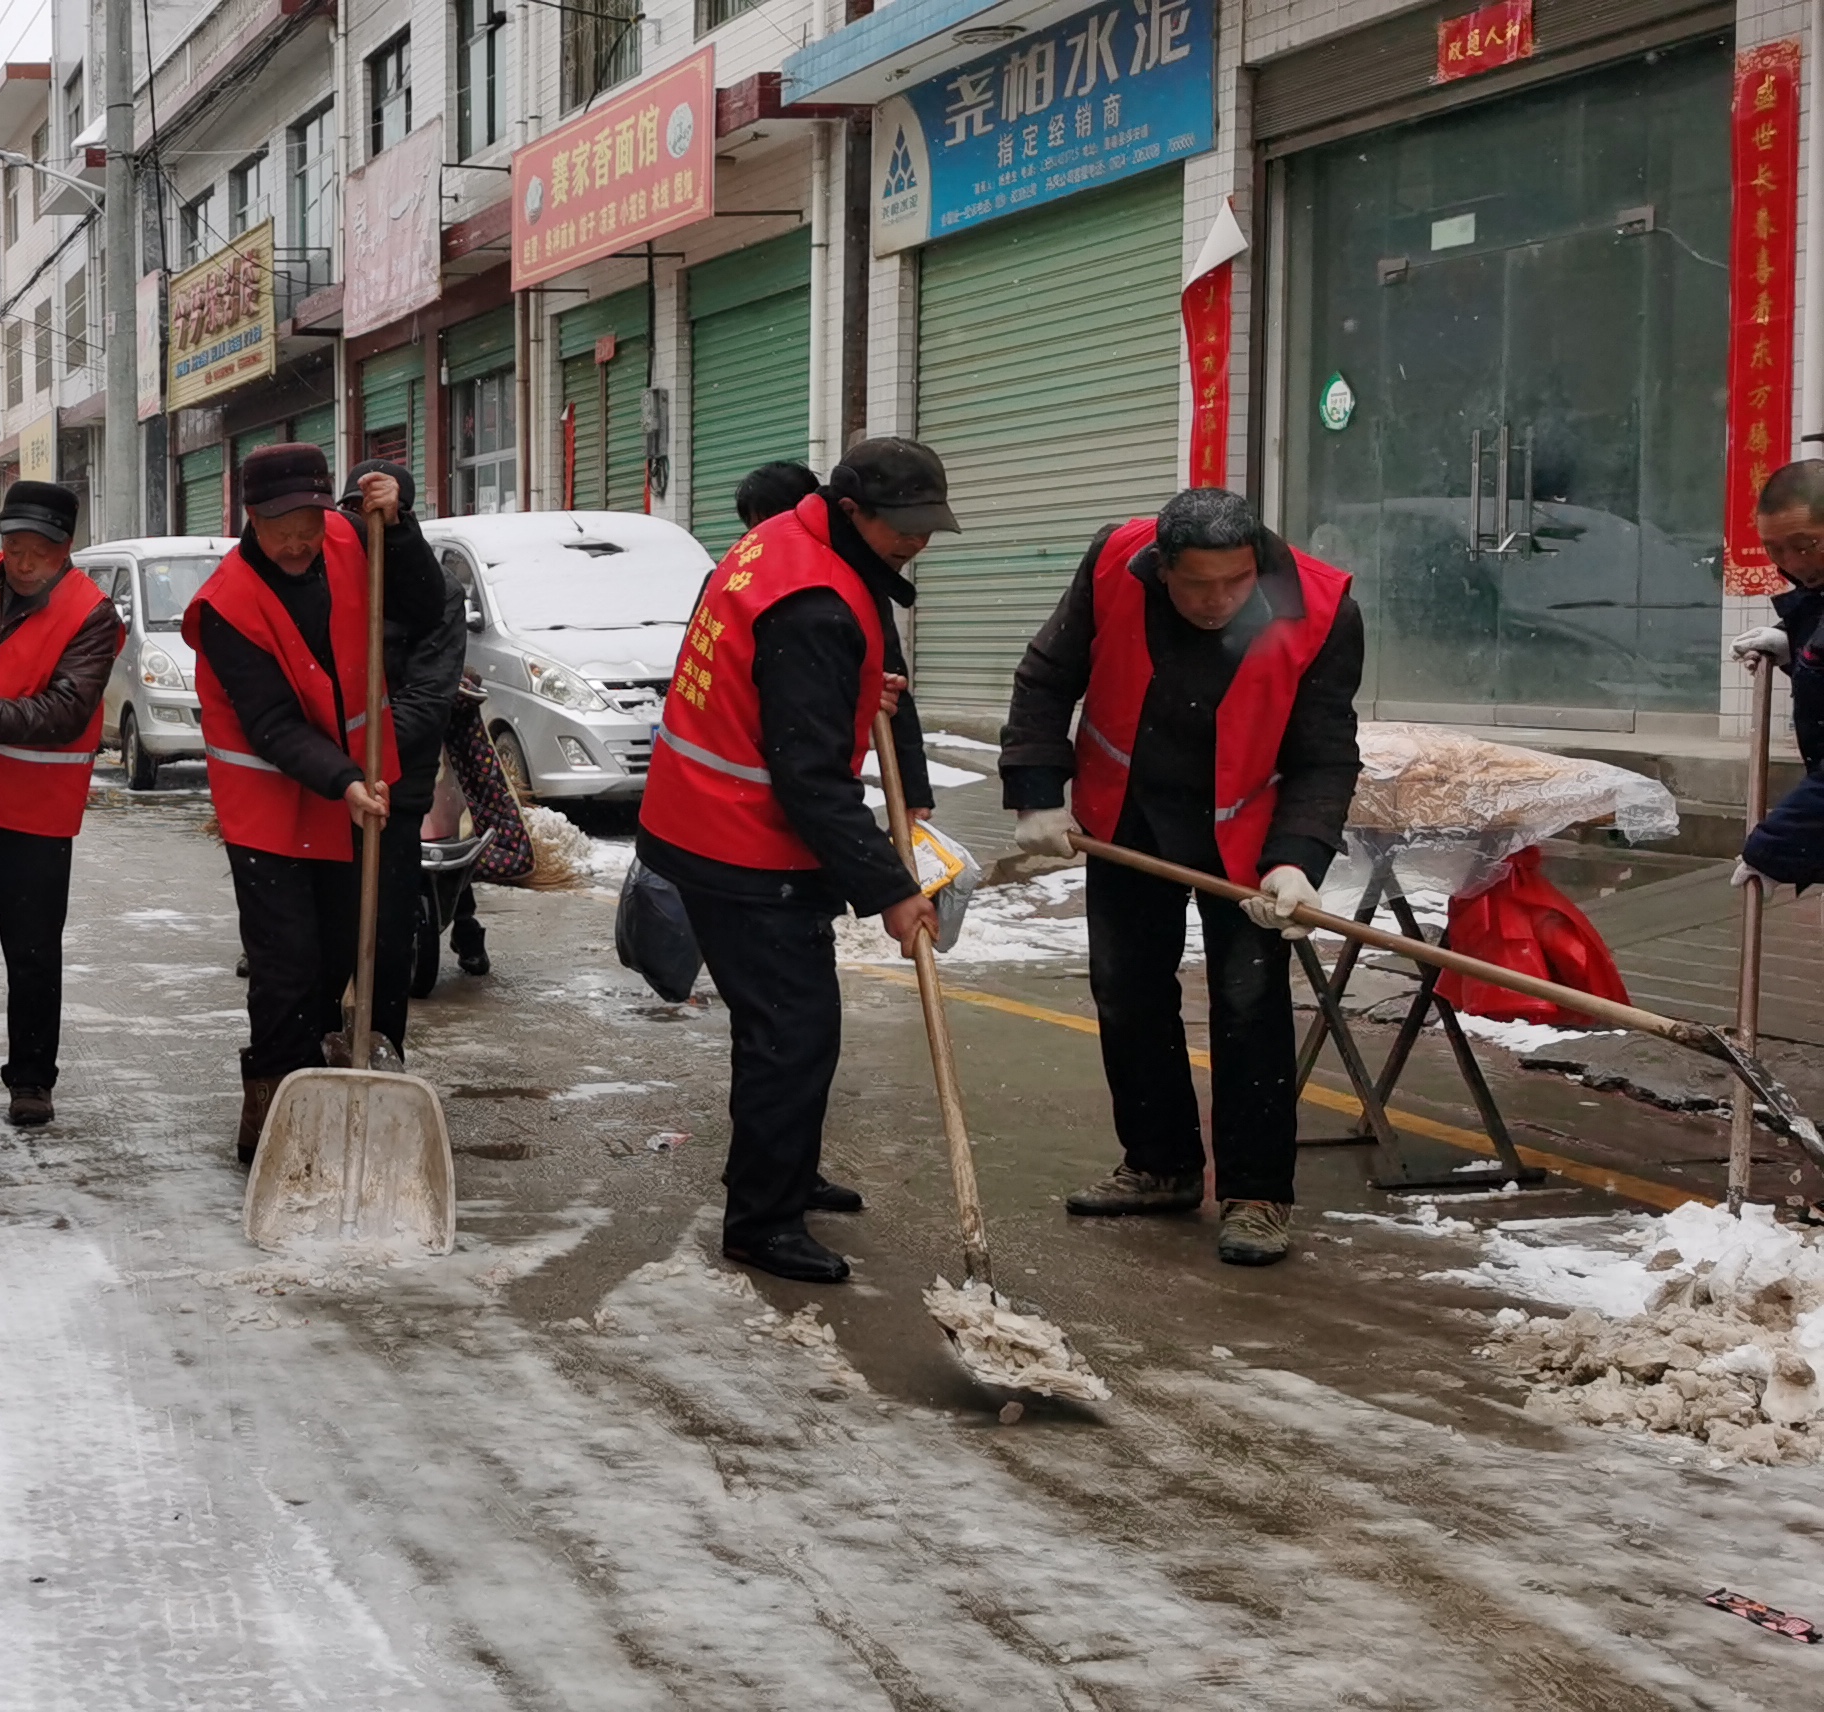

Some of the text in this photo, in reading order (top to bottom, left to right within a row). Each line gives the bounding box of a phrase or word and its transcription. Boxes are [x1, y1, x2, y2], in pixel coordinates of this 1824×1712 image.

[944, 0, 1192, 147] 尧柏水泥
[997, 92, 1123, 168] 指定经销商
